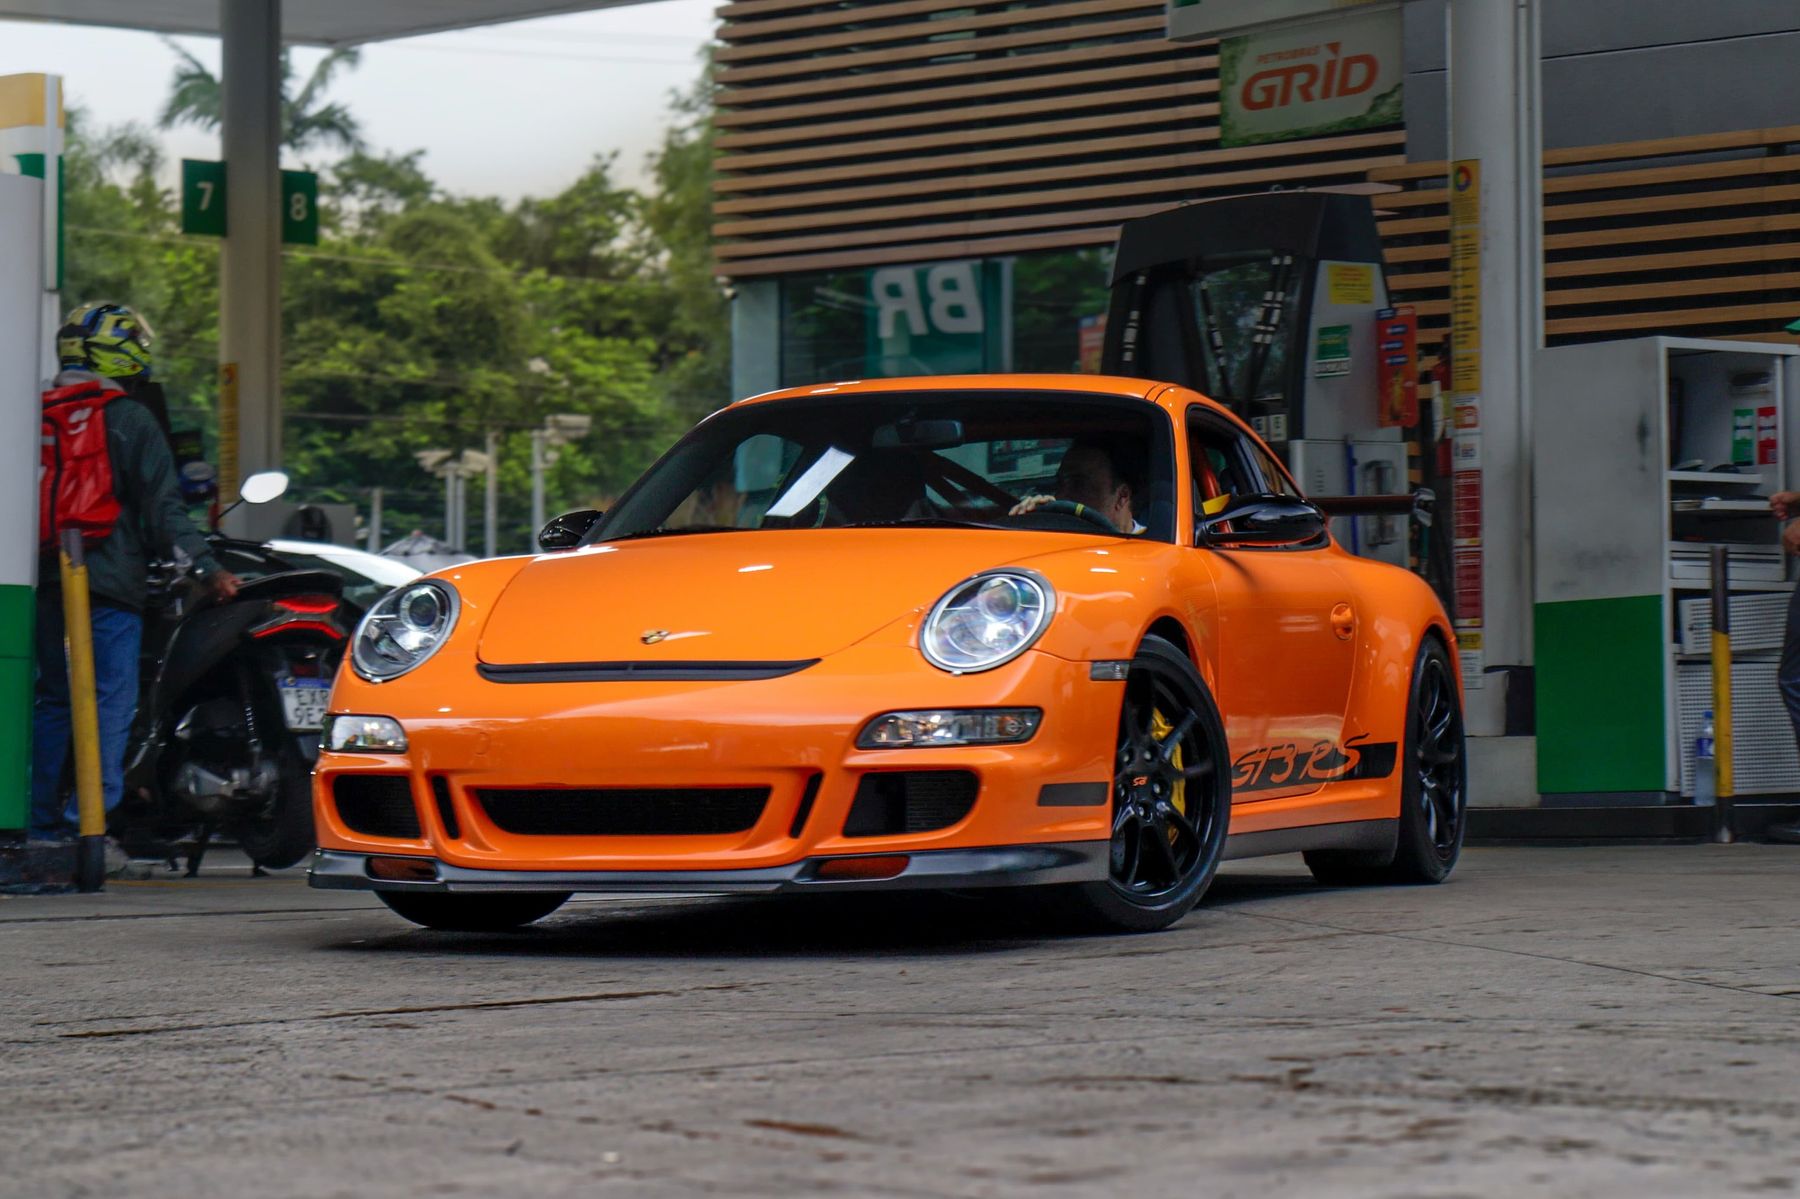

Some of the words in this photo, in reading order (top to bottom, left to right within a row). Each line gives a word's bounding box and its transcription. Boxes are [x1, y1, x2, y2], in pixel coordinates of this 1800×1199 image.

[1241, 42, 1379, 111] GRID
[196, 181, 215, 211] 7
[289, 192, 308, 221] 8
[1232, 743, 1296, 788] GT3
[1300, 733, 1370, 779] RS
